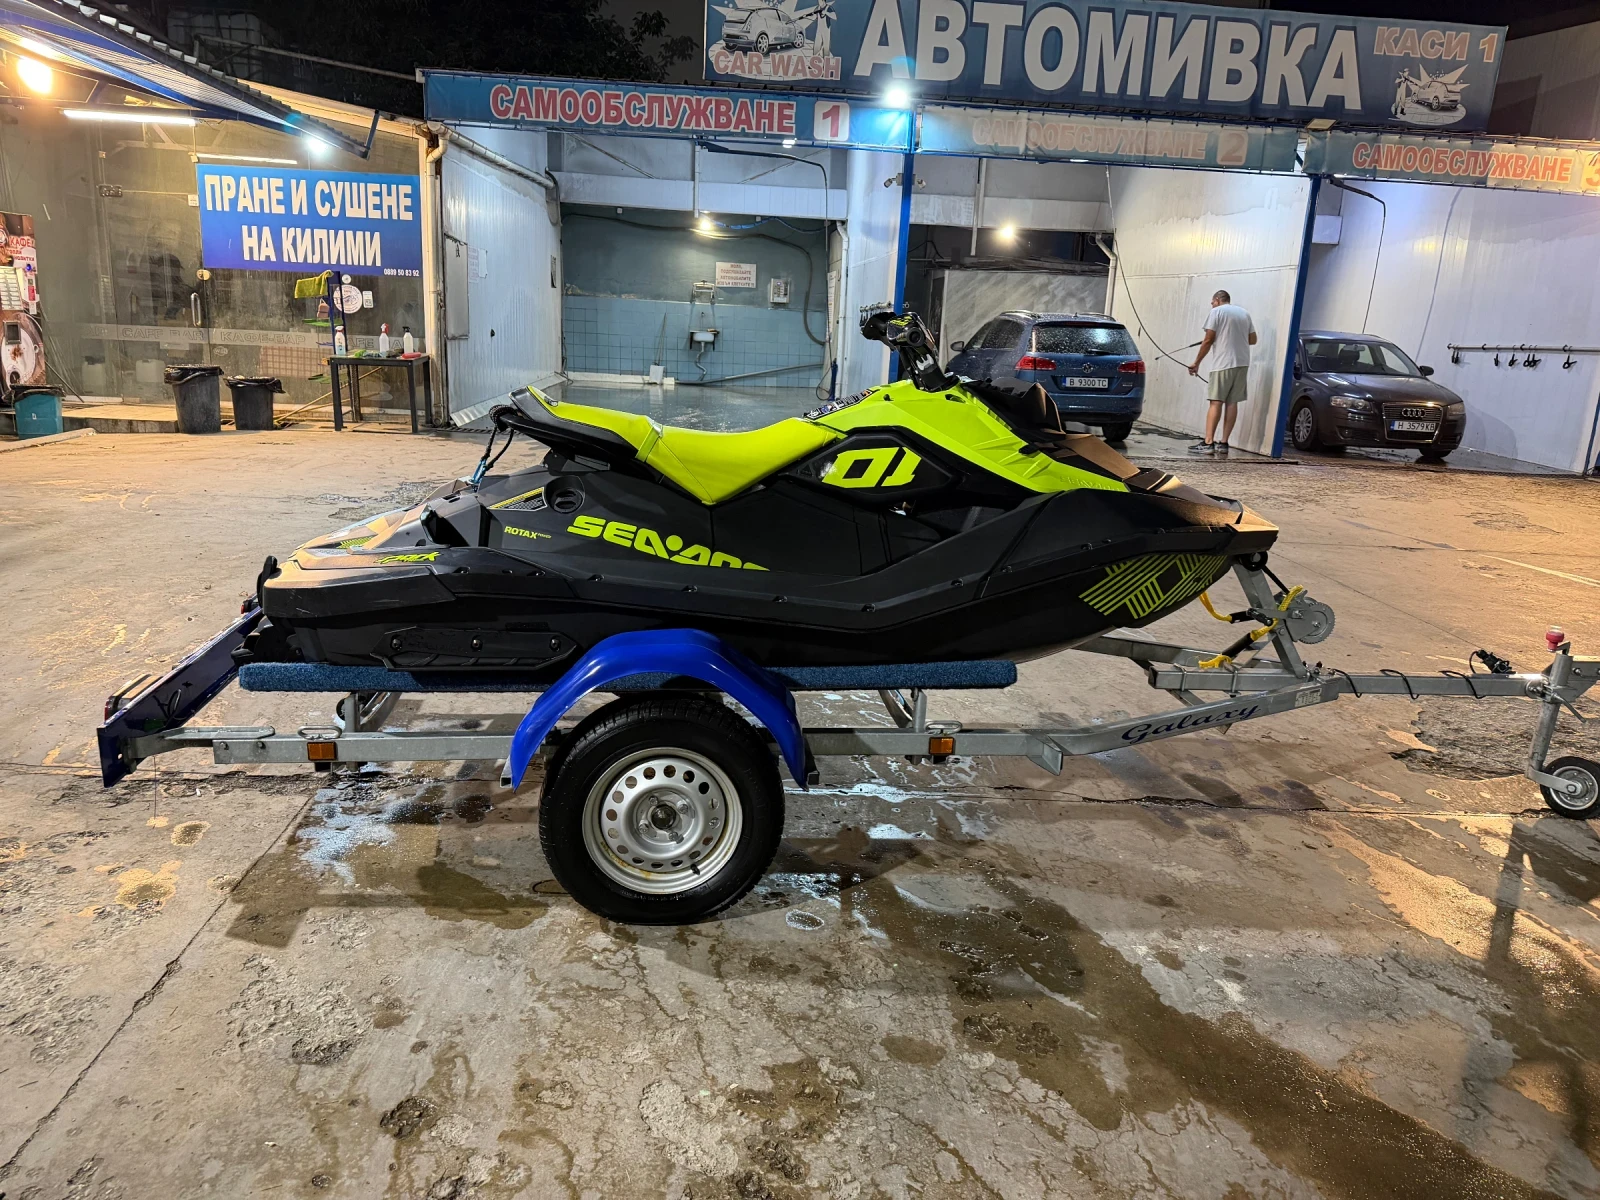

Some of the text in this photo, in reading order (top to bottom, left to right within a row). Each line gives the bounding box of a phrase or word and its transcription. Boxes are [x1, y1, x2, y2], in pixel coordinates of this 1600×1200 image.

[853, 0, 1362, 111] АВТОМИВКА
[1373, 26, 1499, 63] КАСИ 1
[713, 50, 842, 81] CAR WASH
[490, 85, 841, 138] САМООБСЛУЖВАНЕ 1
[972, 117, 1245, 163] САМООБСЛУЖВАНЕ 2
[1353, 141, 1574, 184] САМООБСЛУЖВАНЕ
[204, 174, 413, 221] ПРАНЕ И СУШЕНЕ
[241, 225, 382, 267] НА КИЛИМИ
[220, 331, 306, 345] КАФЕ-БАР
[1069, 378, 1107, 387] B 9300 TC
[1397, 421, 1404, 429] H
[1406, 422, 1425, 430] 3579
[821, 446, 922, 489] 01
[504, 525, 538, 540] ROTAX
[1121, 704, 1262, 745] Galaxy
